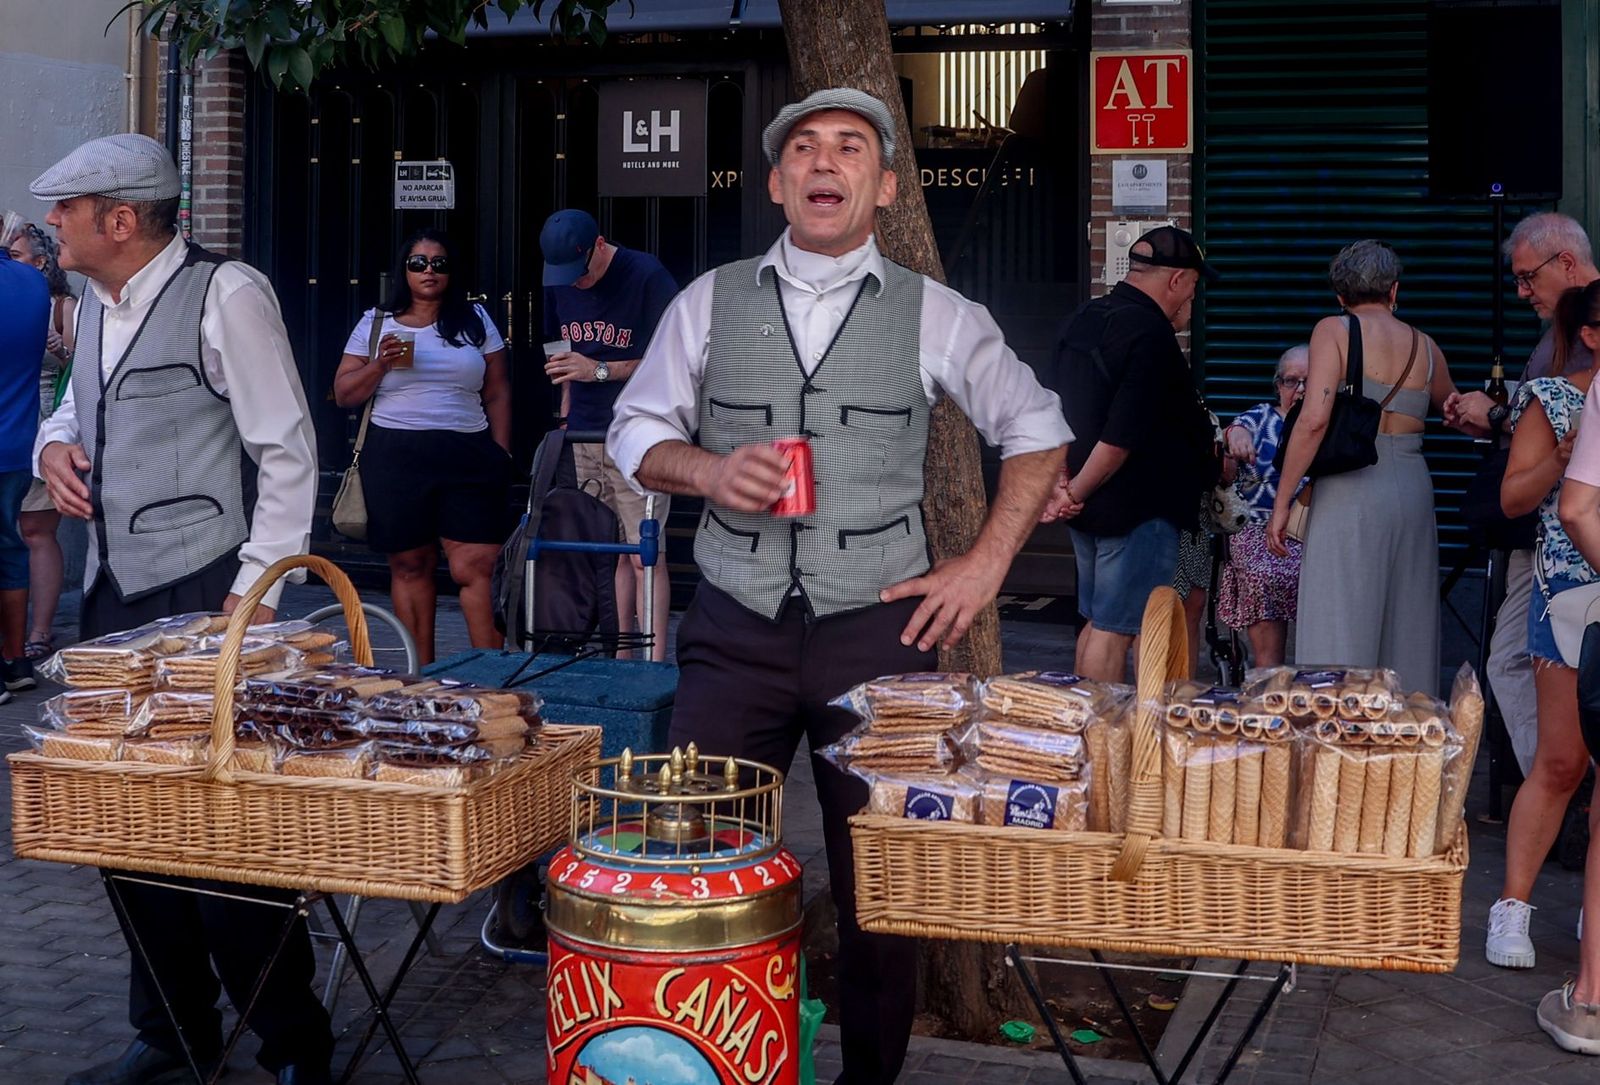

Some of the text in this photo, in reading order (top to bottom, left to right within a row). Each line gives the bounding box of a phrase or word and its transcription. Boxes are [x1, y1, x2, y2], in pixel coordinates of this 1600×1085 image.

[1103, 59, 1180, 109] AT
[623, 110, 680, 152] L&H
[623, 161, 645, 169] HOTELS
[711, 170, 743, 188] XP
[561, 321, 632, 348] BOSTON
[1011, 816, 1045, 829] MADRID
[558, 861, 579, 883] 3
[580, 868, 600, 889] 5
[611, 872, 632, 894] 2
[650, 876, 668, 898] 4
[690, 876, 710, 900] 3
[728, 871, 743, 895] 1
[754, 865, 775, 886] 2
[549, 960, 778, 1083] FELIX CAÑAS
